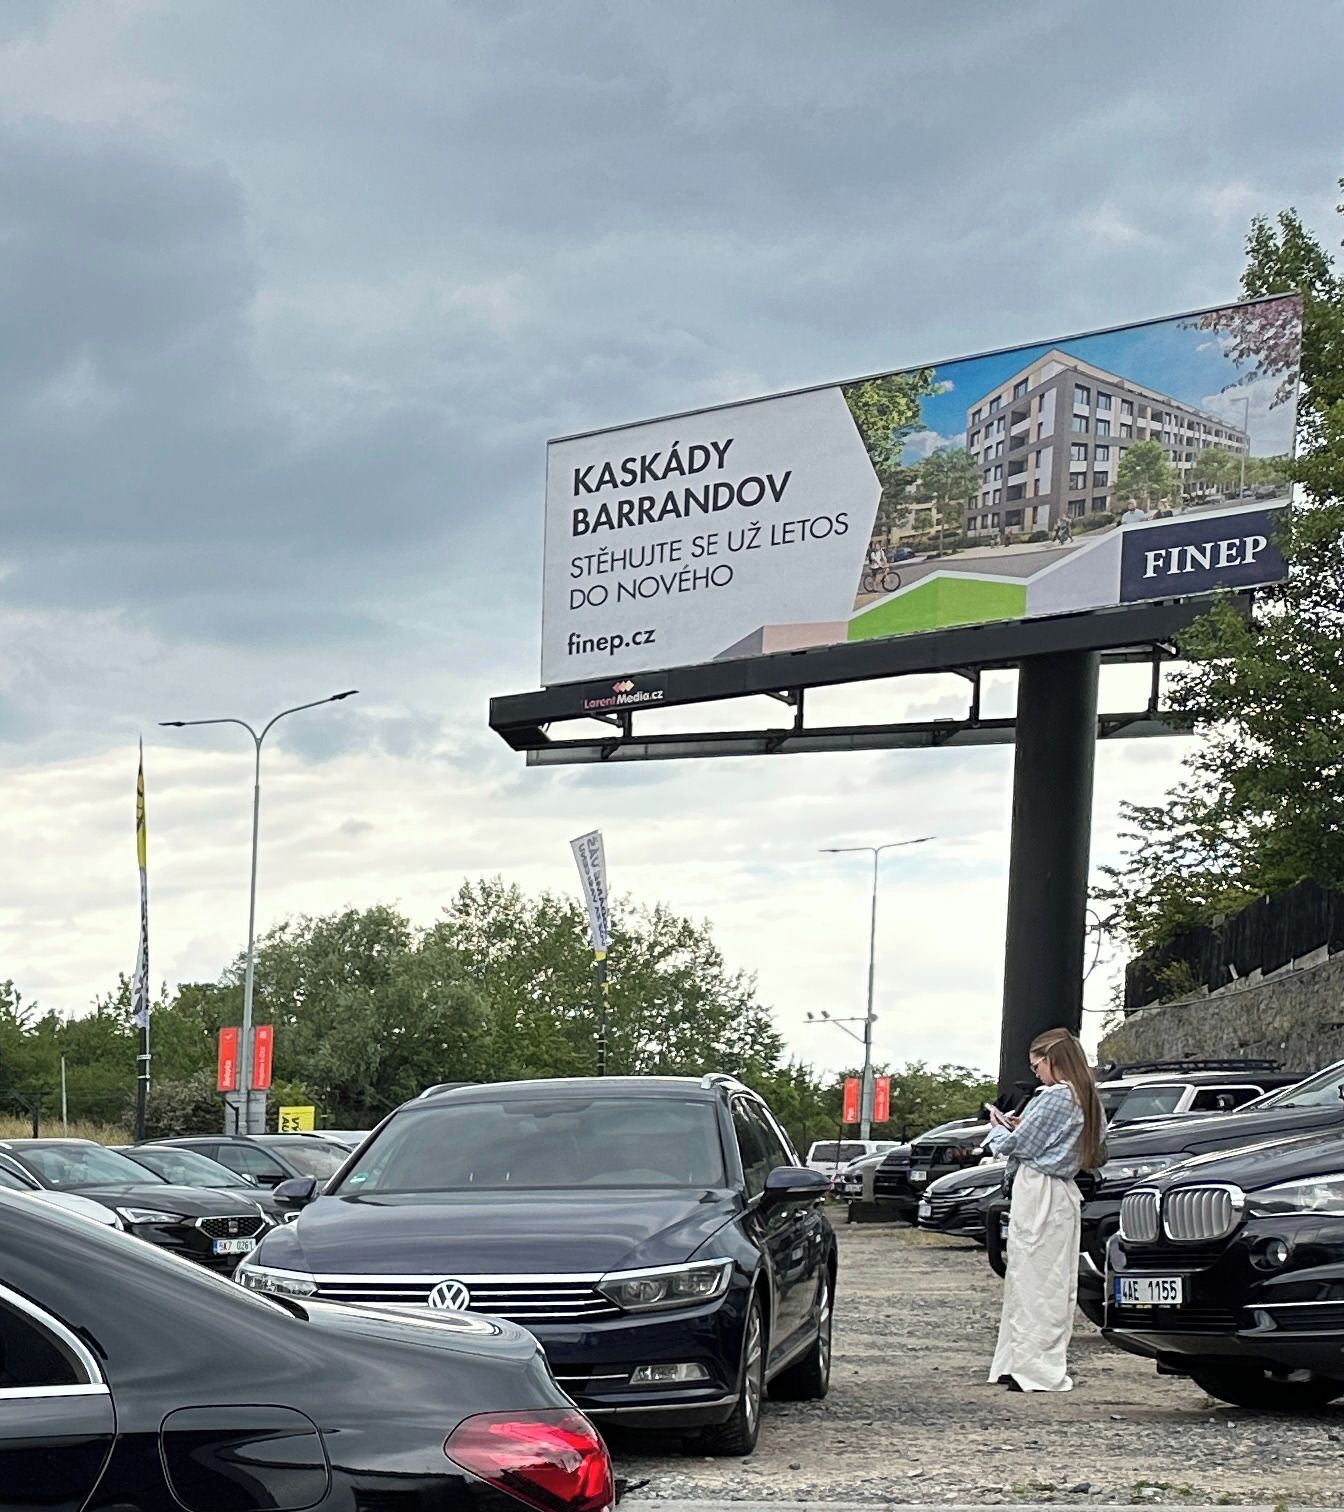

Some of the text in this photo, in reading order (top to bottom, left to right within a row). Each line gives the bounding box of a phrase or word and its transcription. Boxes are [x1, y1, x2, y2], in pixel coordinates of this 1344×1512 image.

[573, 439, 734, 496] KASKÁDY
[572, 471, 792, 537] BARRANDOV
[570, 512, 849, 579] STĚHUJTE SE UŽ LETOS
[1142, 535, 1268, 579] FINEP
[570, 564, 733, 610] DO NOVÉHO
[567, 629, 656, 656] finep.cz
[1122, 1280, 1178, 1301] 4AE 1155
